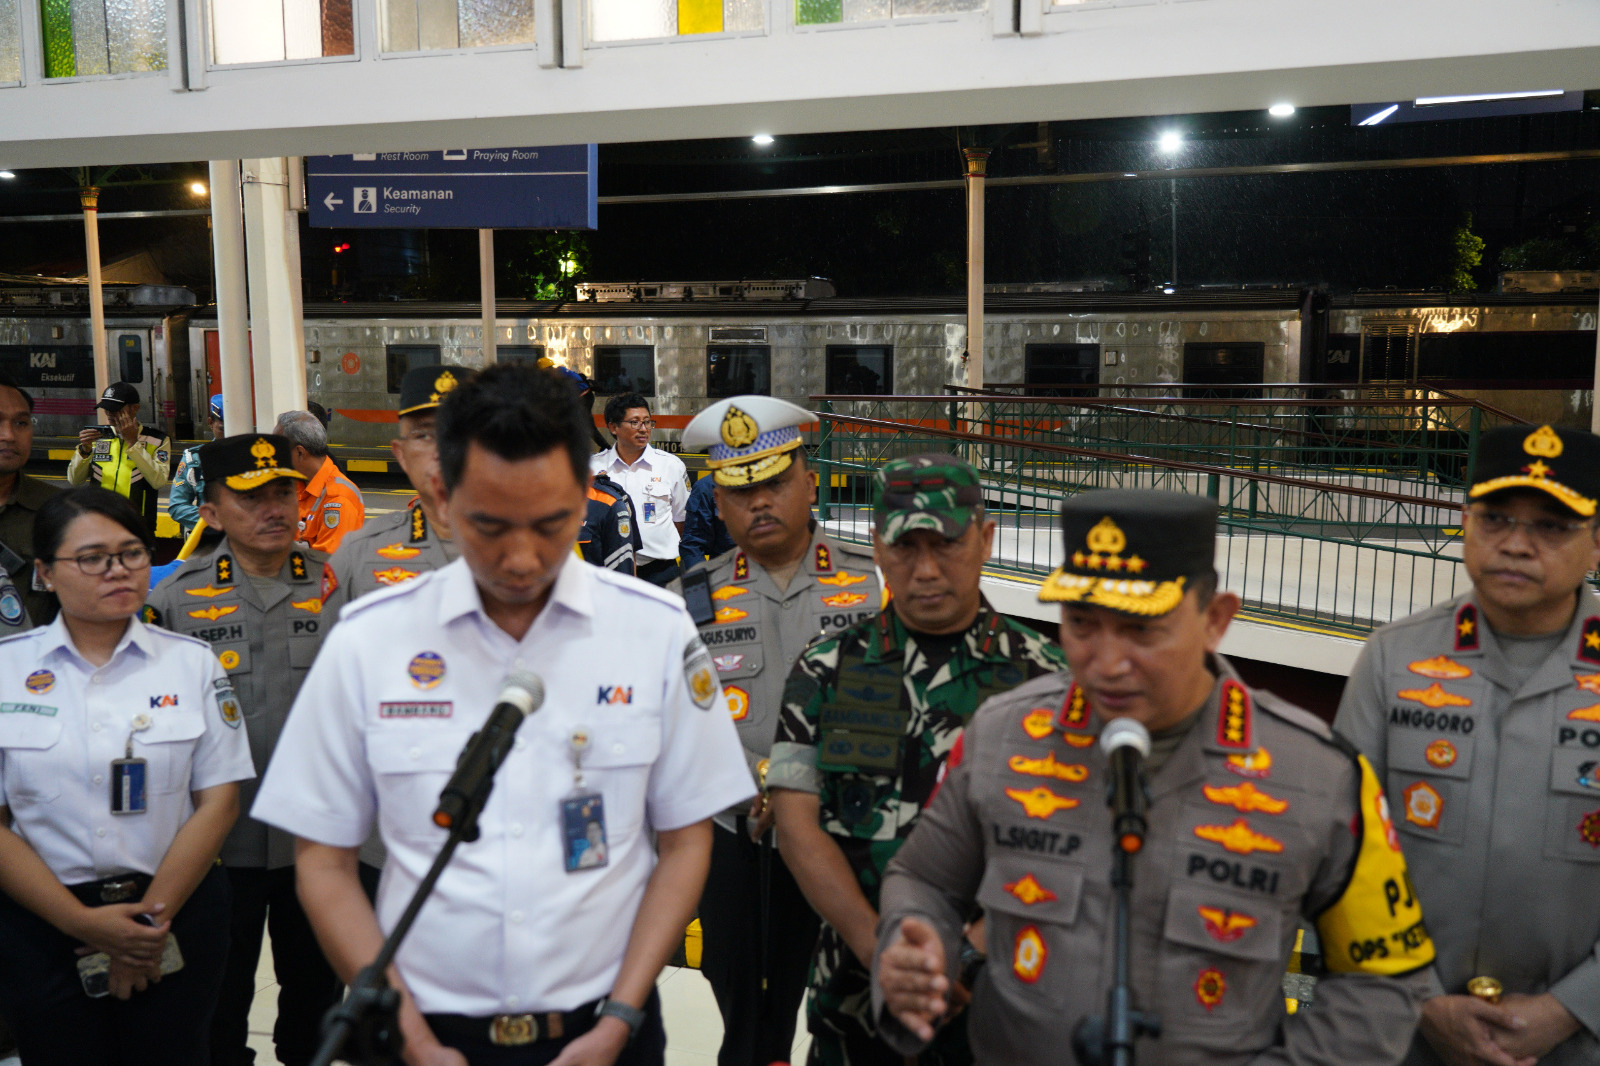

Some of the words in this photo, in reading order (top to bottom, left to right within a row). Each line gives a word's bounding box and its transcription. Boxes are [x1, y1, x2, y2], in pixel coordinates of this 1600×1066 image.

[381, 151, 401, 161] Rest
[403, 151, 429, 161] Room
[473, 150, 509, 162] Praying
[512, 150, 538, 160] Room
[383, 187, 453, 200] Keamanan
[383, 203, 421, 215] Security
[30, 353, 56, 368] KAI
[41, 373, 75, 382] Eksekutif
[725, 627, 756, 644] SURYO
[150, 694, 178, 709] KAI
[597, 685, 632, 705] KAI
[1390, 707, 1475, 734] ANGGORO
[1187, 854, 1280, 894] POLRI
